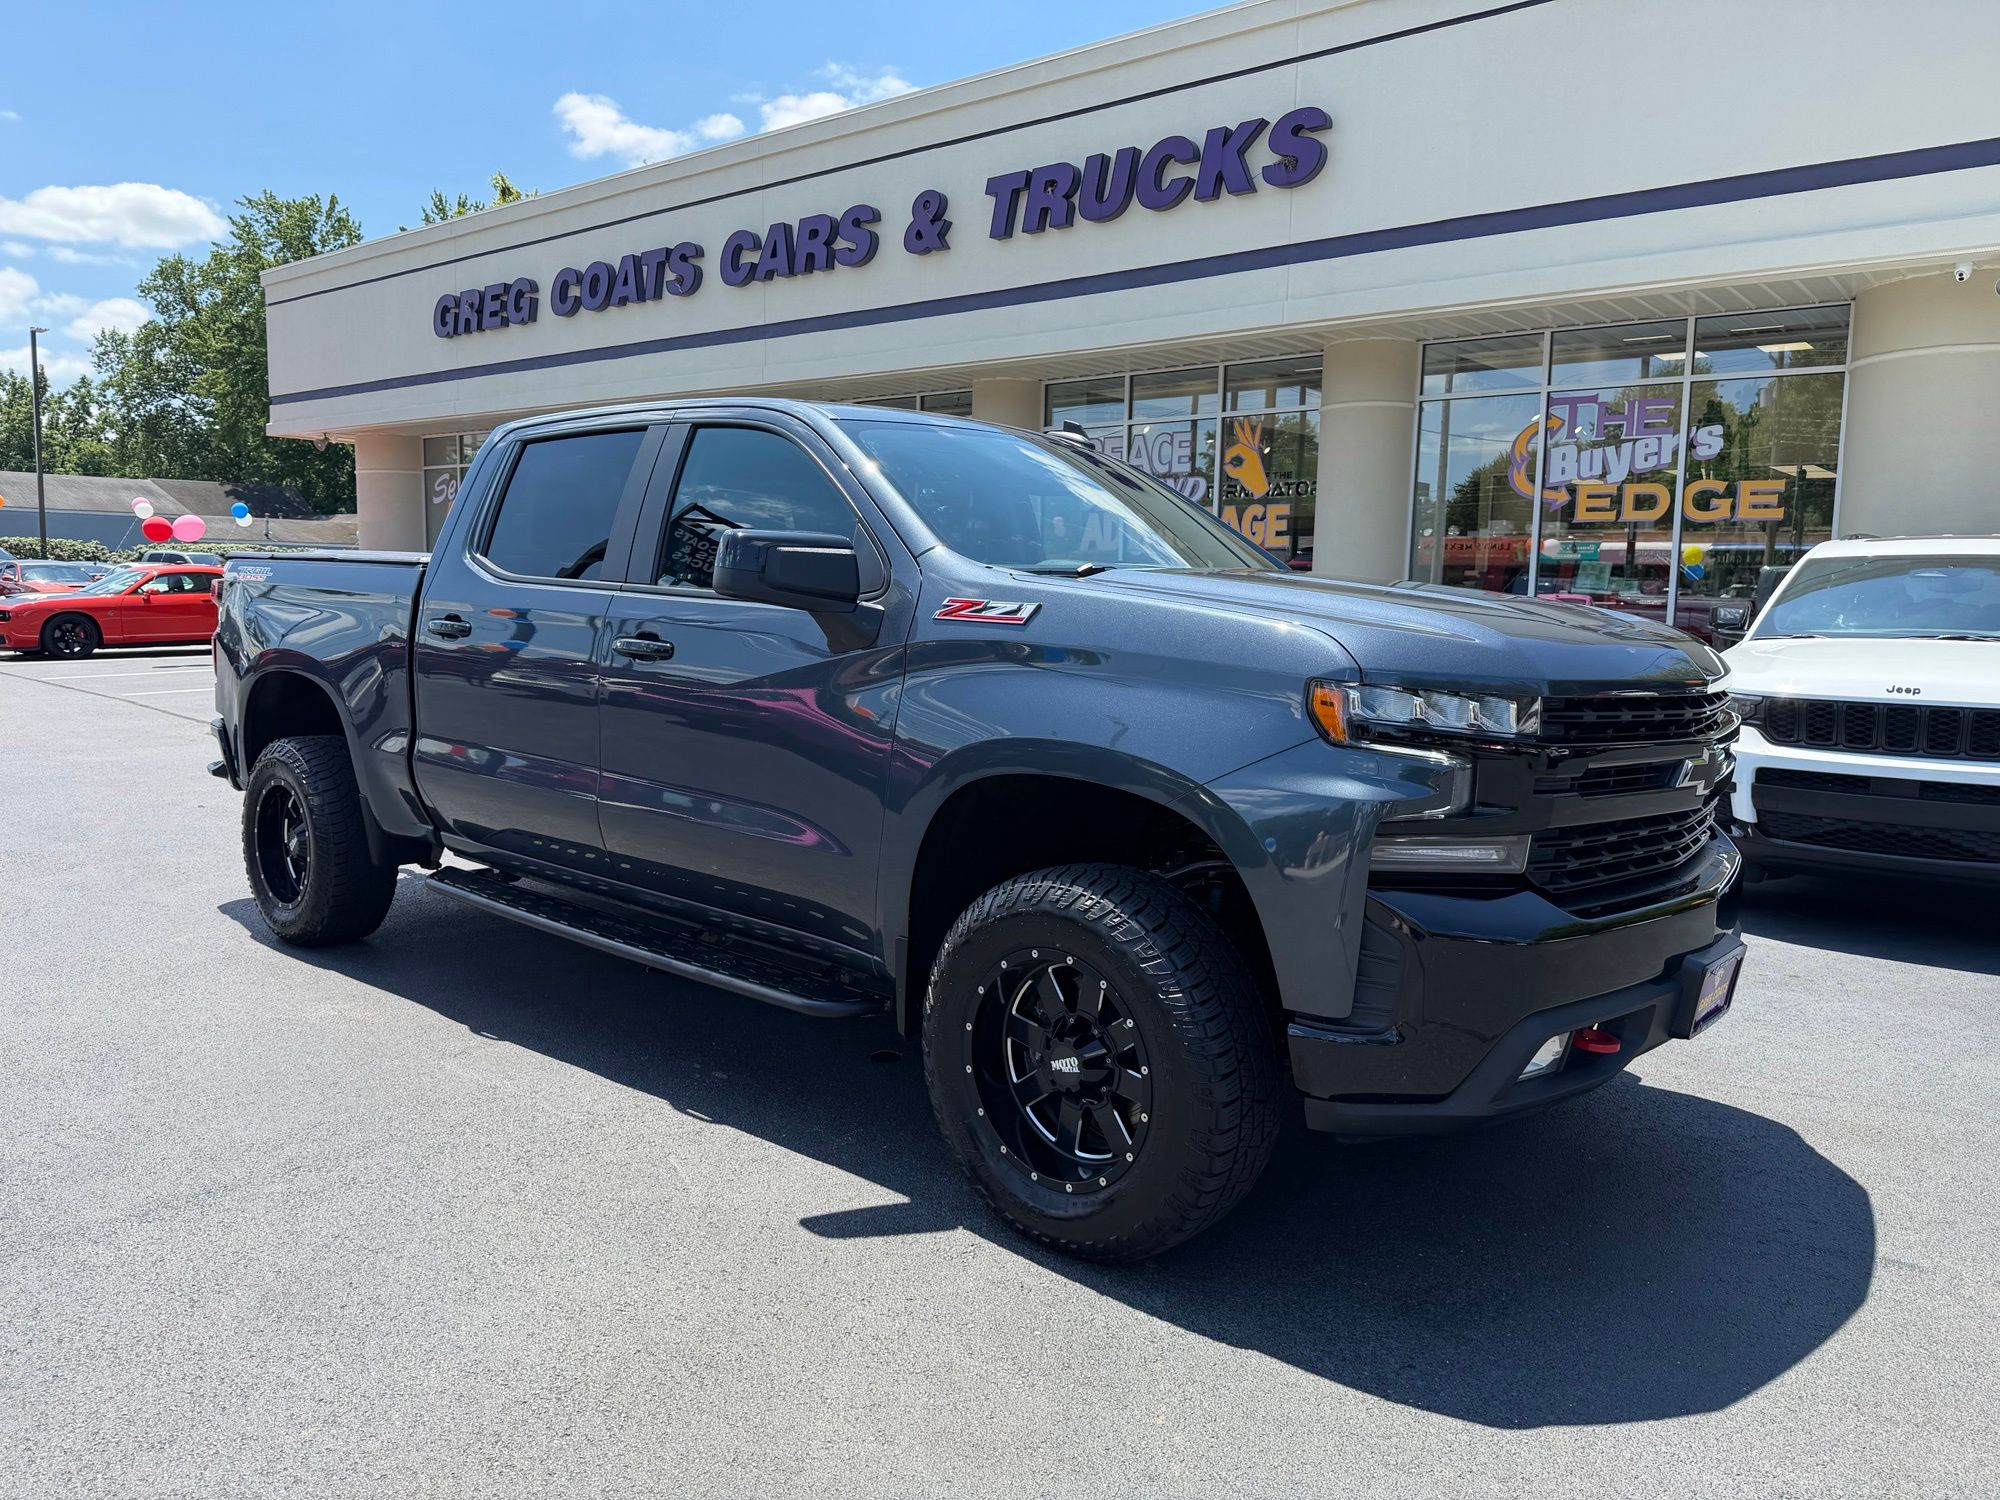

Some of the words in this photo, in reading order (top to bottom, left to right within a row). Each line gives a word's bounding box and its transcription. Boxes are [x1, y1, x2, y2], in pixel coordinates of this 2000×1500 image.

[433, 277, 539, 339] GREG
[550, 241, 705, 318] COATS
[720, 204, 882, 288] CARS
[903, 189, 951, 255] &
[986, 106, 1332, 241] TRUCKS
[1549, 393, 1677, 441] THE
[1274, 471, 1293, 480] THE
[1572, 478, 1786, 524] EDGE
[1219, 503, 1291, 549] AGE
[238, 566, 273, 576] TRAIL
[932, 597, 1042, 625] Z71
[1886, 685, 1921, 696] Jeep
[1050, 1057, 1079, 1071] MOTO
